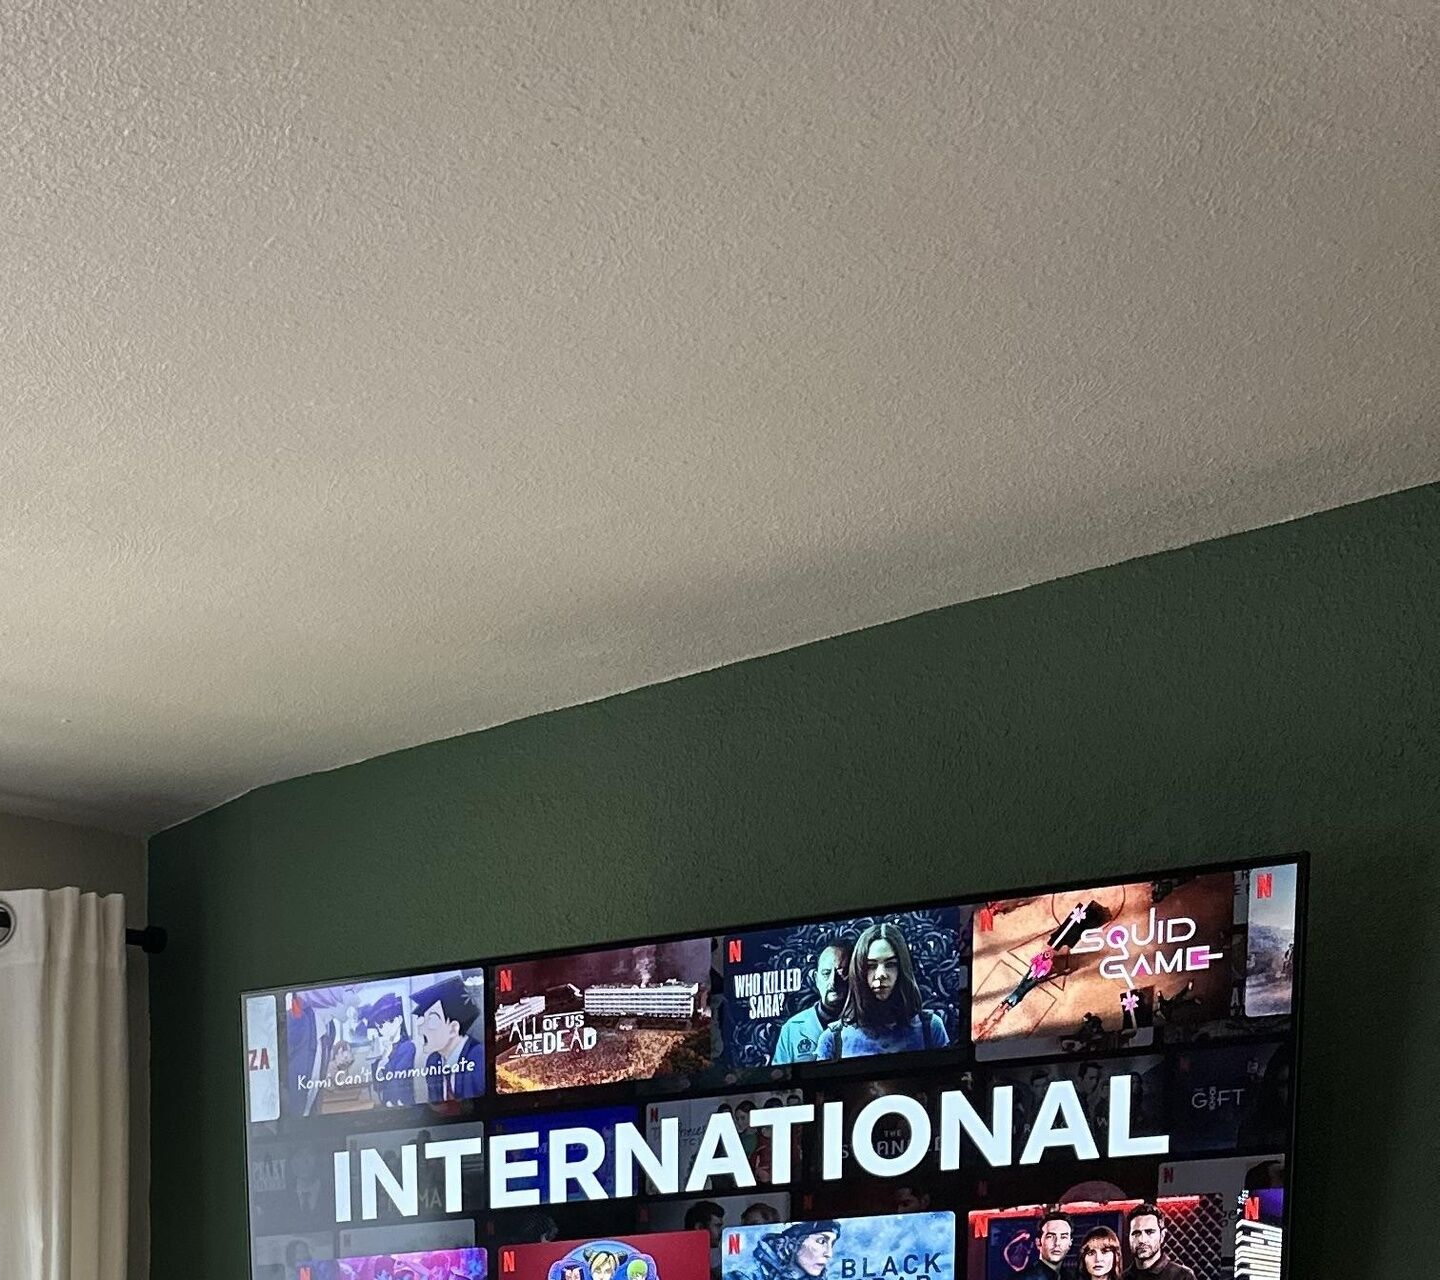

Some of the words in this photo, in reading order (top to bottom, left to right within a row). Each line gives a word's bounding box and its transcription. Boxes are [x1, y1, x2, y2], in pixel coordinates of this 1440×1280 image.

[1070, 907, 1196, 955] SQUID
[729, 940, 742, 963] N
[1100, 945, 1223, 980] GAME
[500, 969, 513, 992] N
[734, 973, 761, 998] WHO
[763, 968, 802, 994] KILLED
[749, 993, 785, 1019] SARA?
[509, 1017, 542, 1042] ALL
[543, 1017, 562, 1031] OF
[565, 1014, 585, 1029] US
[515, 1040, 542, 1054] ARE
[543, 1027, 597, 1054] DEAD
[297, 1074, 331, 1090] Komi
[335, 1068, 372, 1087] Can't
[375, 1057, 475, 1082] Communicate
[334, 1074, 1170, 1222] INTERNATIONAL
[503, 1251, 515, 1272] N
[841, 1252, 942, 1279] BLACK
